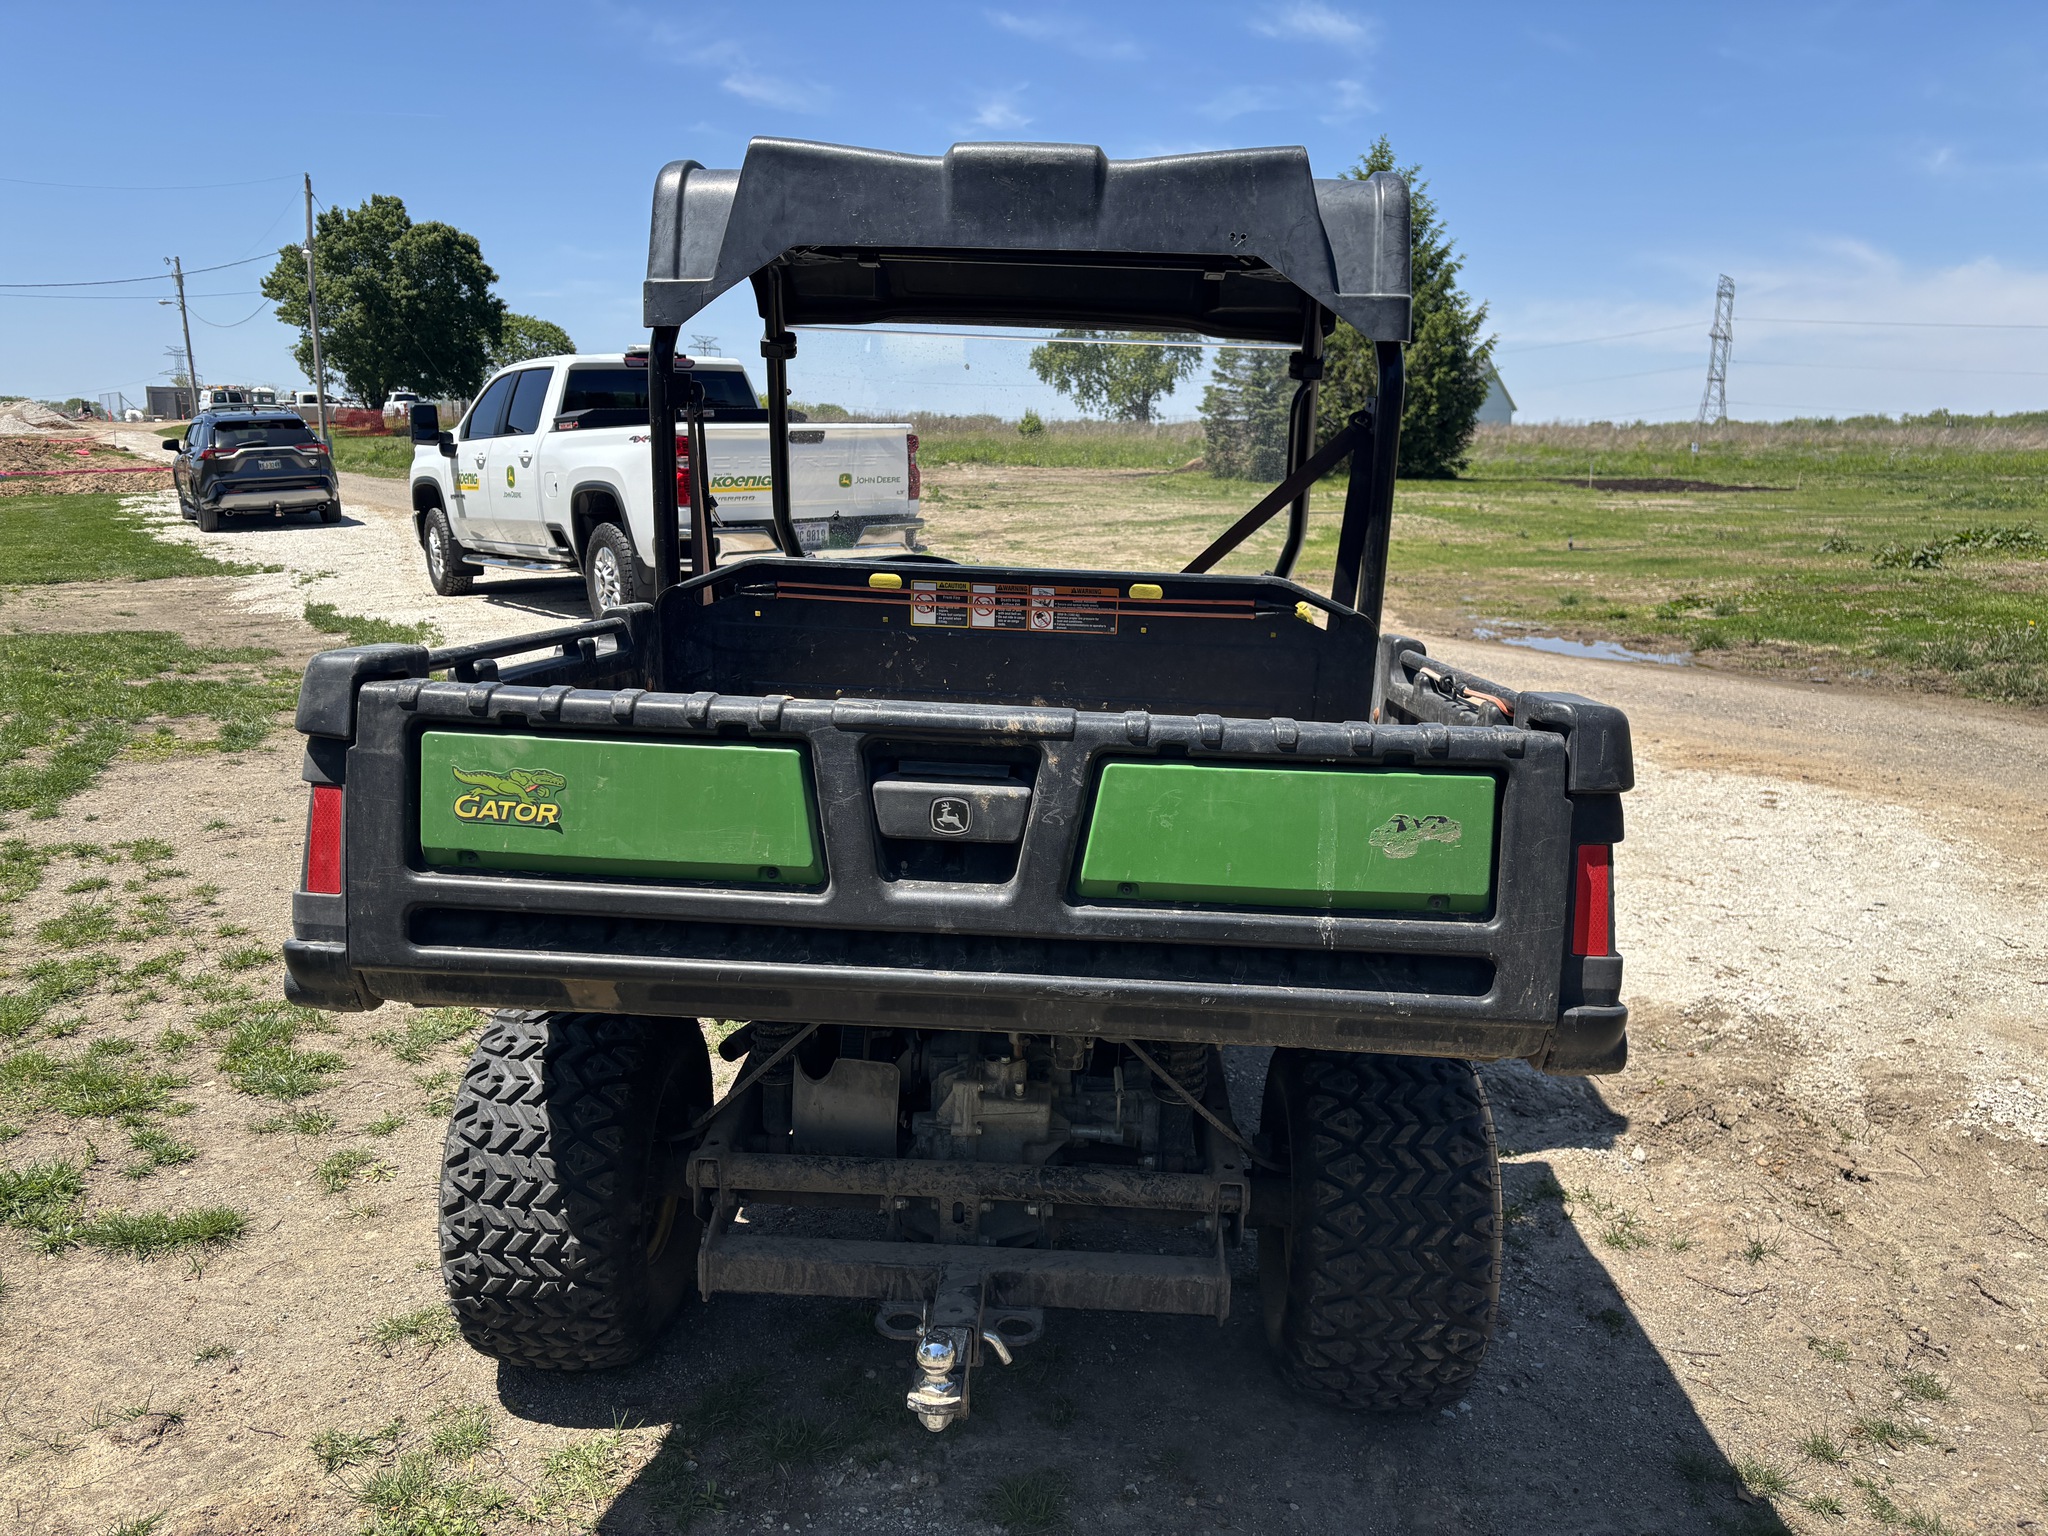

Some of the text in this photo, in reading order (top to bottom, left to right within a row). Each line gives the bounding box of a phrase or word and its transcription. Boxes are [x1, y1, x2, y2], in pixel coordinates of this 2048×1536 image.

[854, 476, 902, 484] JOHN DEERE
[454, 795, 558, 824] GATOR
